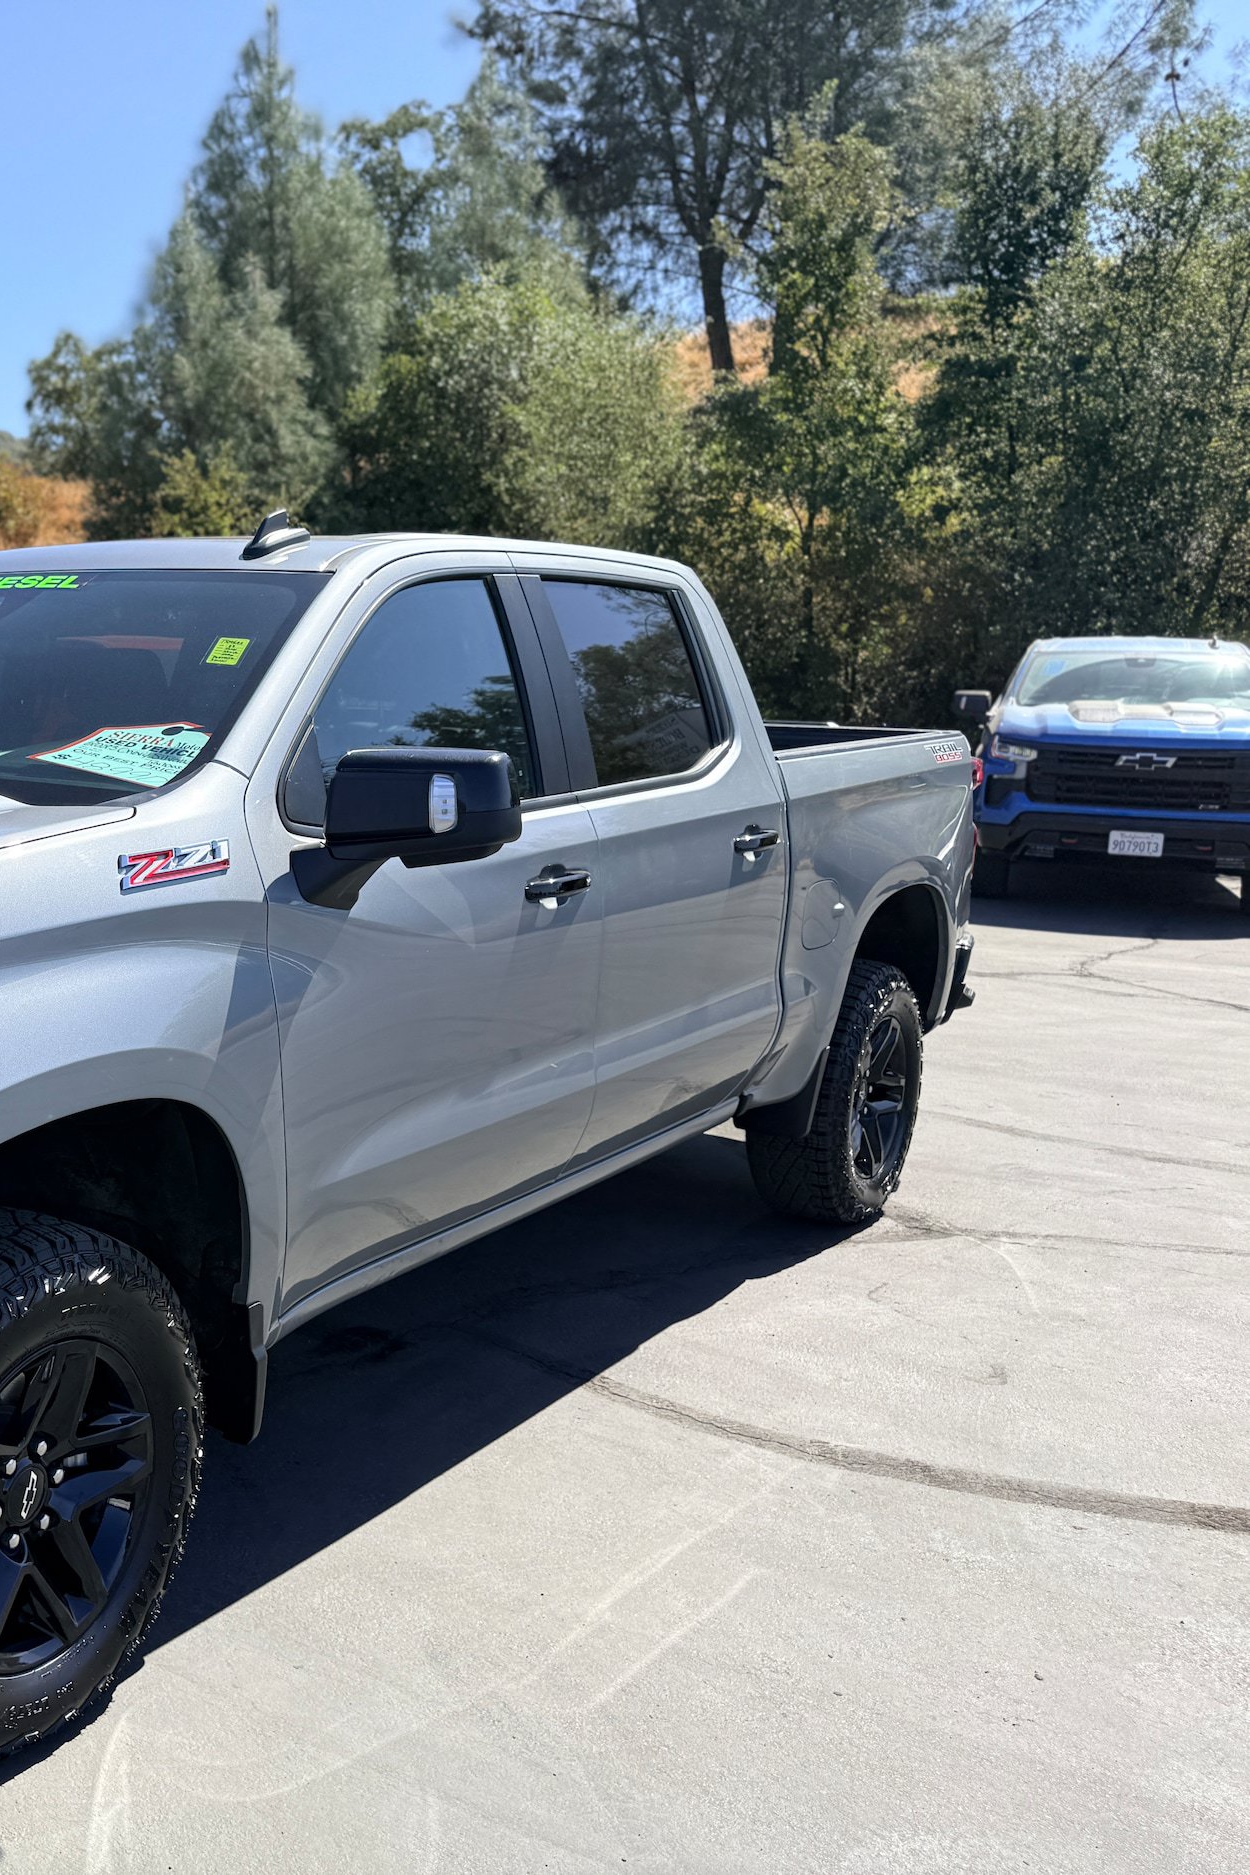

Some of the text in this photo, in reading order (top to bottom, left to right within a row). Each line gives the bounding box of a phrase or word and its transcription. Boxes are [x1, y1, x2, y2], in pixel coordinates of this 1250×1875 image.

[95, 736, 137, 748] USED
[109, 731, 175, 747] SIERRA
[924, 743, 962, 754] TRAIL
[73, 748, 100, 757] OUR
[103, 755, 139, 765] BEST
[935, 753, 962, 762] BOSS
[117, 837, 230, 892] Z71
